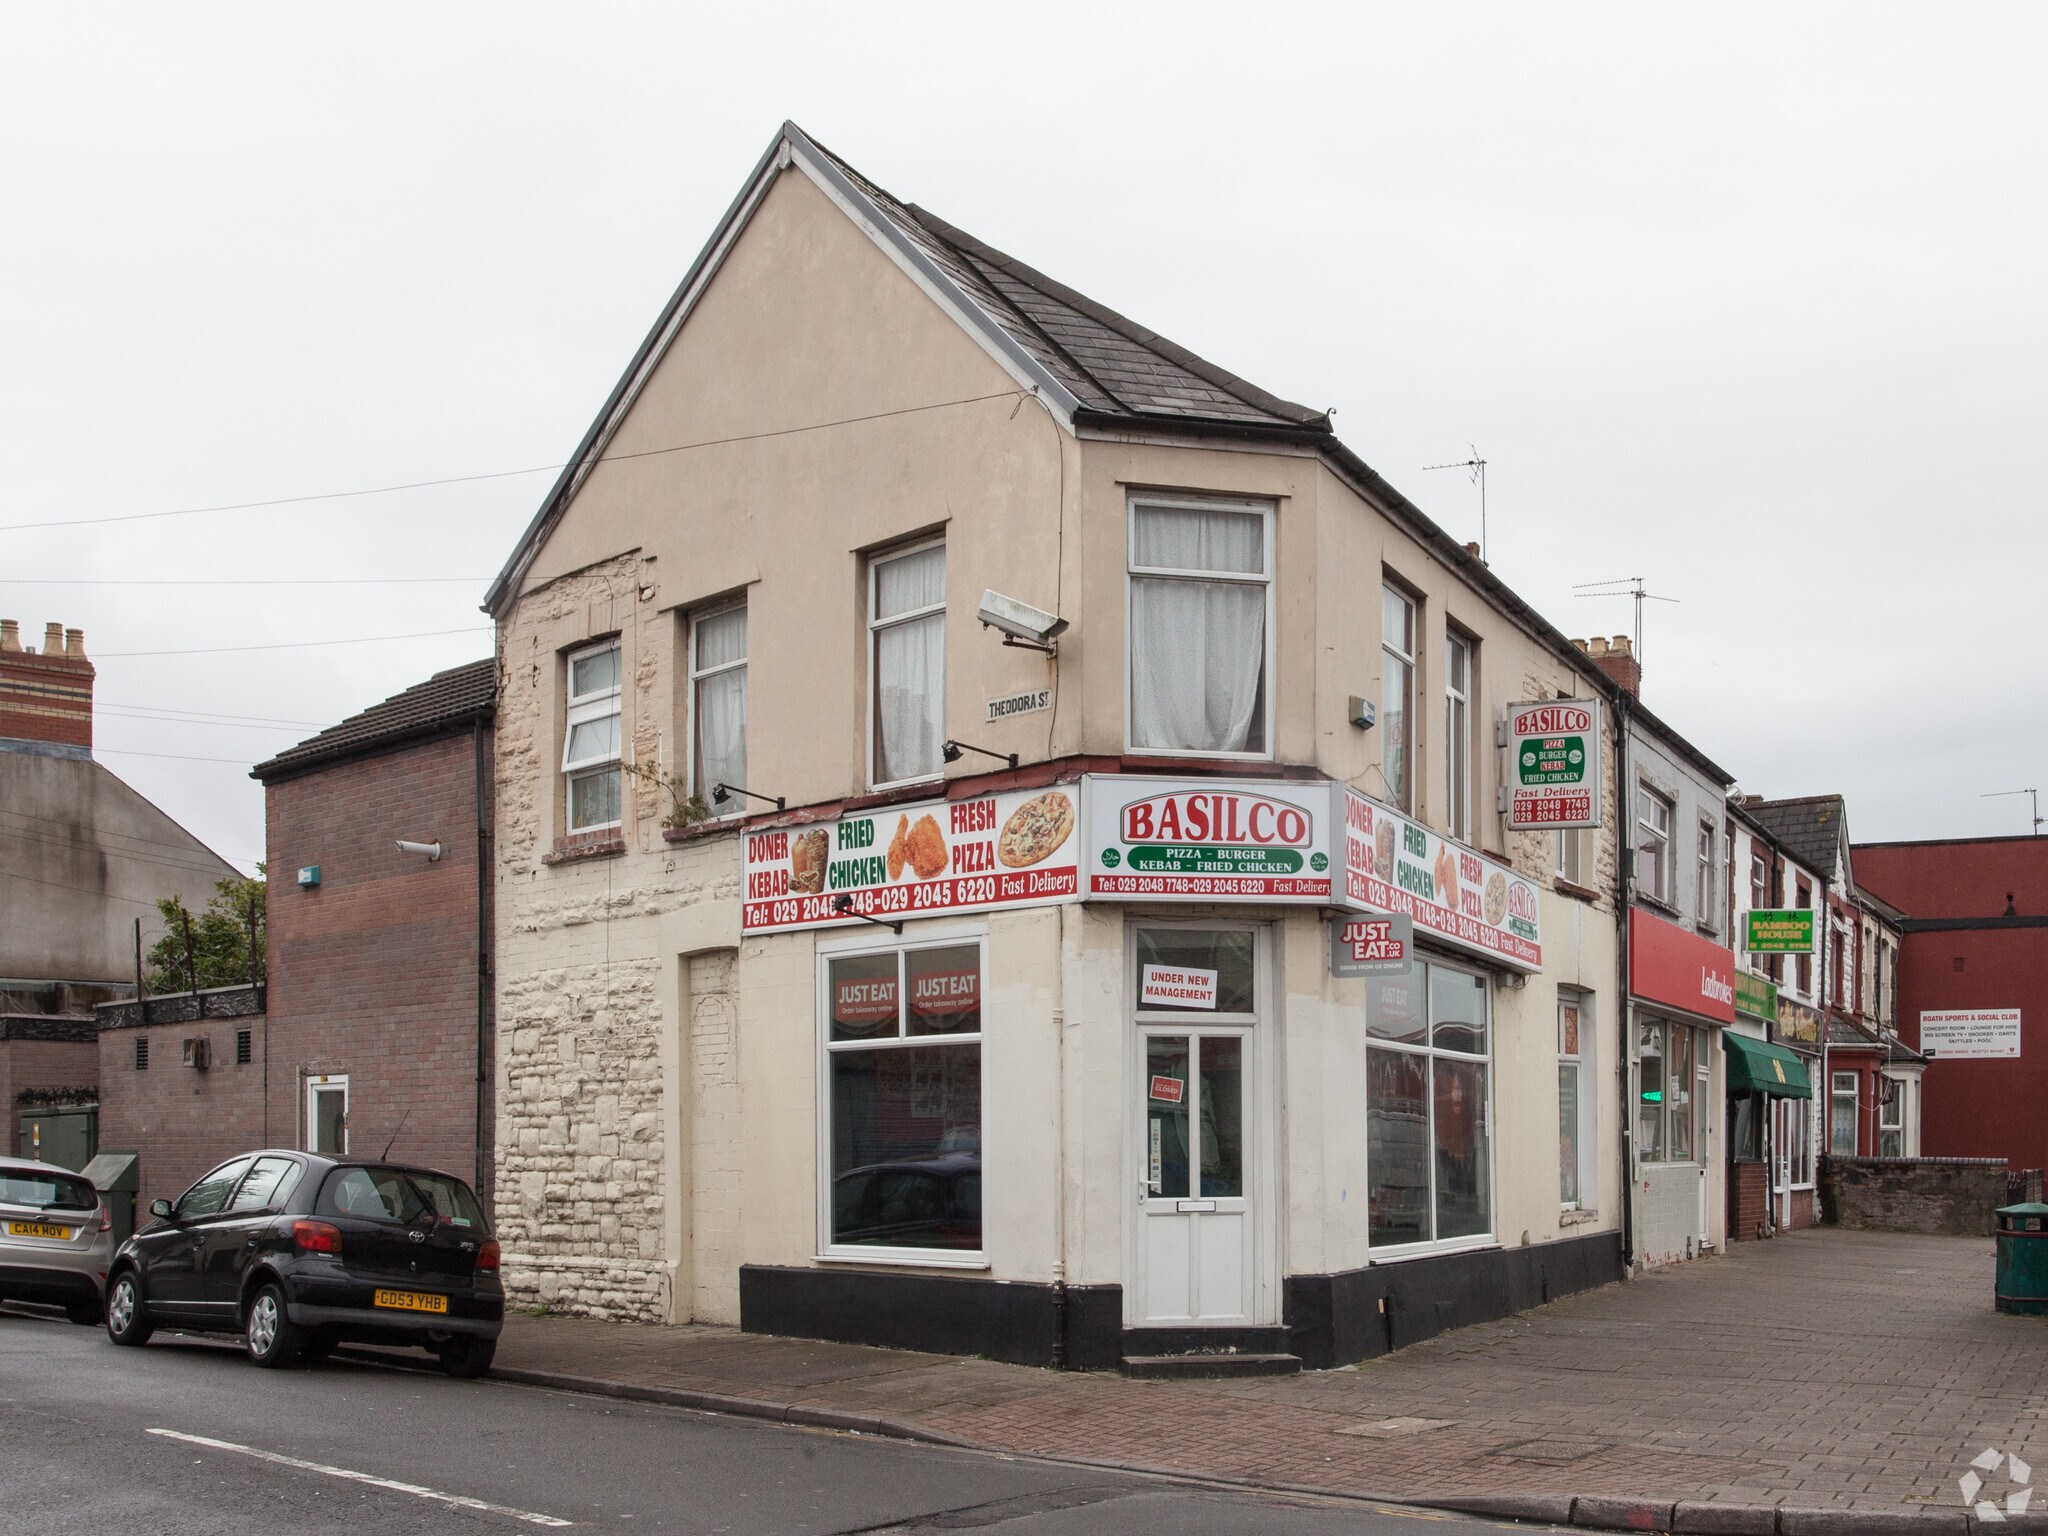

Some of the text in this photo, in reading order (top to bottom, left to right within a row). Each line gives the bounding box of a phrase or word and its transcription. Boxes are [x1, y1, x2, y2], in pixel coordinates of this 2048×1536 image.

[989, 694, 1036, 718] THEODORA
[1518, 709, 1588, 733] BASILCO
[1544, 740, 1564, 749] PIZZA
[1539, 751, 1567, 759] BURGER
[1541, 762, 1565, 771] KEBAB
[1525, 772, 1578, 783] FRIED CHICKEN
[1514, 787, 1590, 798] Fast Delivery
[1515, 799, 1587, 811] 029 2048 7748
[951, 799, 996, 834] FRESH
[1128, 795, 1305, 843] BASILCO
[1515, 810, 1588, 821] 029 2045 6220
[838, 819, 874, 850] FRIED
[1404, 822, 1426, 858] FRIED
[749, 832, 788, 863] DONER
[1166, 849, 1201, 858] PIZZA
[1218, 850, 1266, 860] BURGER
[952, 841, 995, 874] PIZZA
[1139, 860, 1181, 870] KEBAB
[1197, 862, 1233, 871] FRIED
[1238, 863, 1292, 872] CHICKEN
[829, 855, 886, 890] CHICKEN
[1461, 853, 1482, 886] FRESH
[749, 869, 789, 899] KEBAB
[1099, 878, 1331, 896] Tel: 029 2048 7748-029 2045 6220 Fast Delivery
[1397, 859, 1434, 901] CHICKEN
[746, 904, 768, 926] Tel:
[773, 900, 798, 923] 029
[913, 882, 951, 907] 2045
[957, 877, 995, 903] 6220
[1001, 876, 1024, 896] Fast
[1029, 871, 1074, 893] Delivery
[1461, 888, 1482, 920] PIZZA
[1509, 886, 1536, 922] BASILCO
[1348, 872, 1364, 898] Tel:
[1369, 880, 1386, 907] 029
[1460, 918, 1478, 942] 2045
[1480, 925, 1498, 949] 6220
[1343, 923, 1389, 941] JUST
[1753, 922, 1809, 930] BAMBOO
[1355, 941, 1389, 958] EAT
[916, 975, 976, 997] JUST EAT
[1151, 972, 1209, 986] UNDER NEW
[1701, 966, 1732, 1005] Ladbrokes
[839, 983, 895, 1003] JUST EAT
[1146, 986, 1212, 1001] MANAGEMENT
[842, 1006, 854, 1014] Order
[1155, 1085, 1178, 1095] CLOSED
[15, 1223, 39, 1234] CA14
[418, 1295, 441, 1309] YHB
